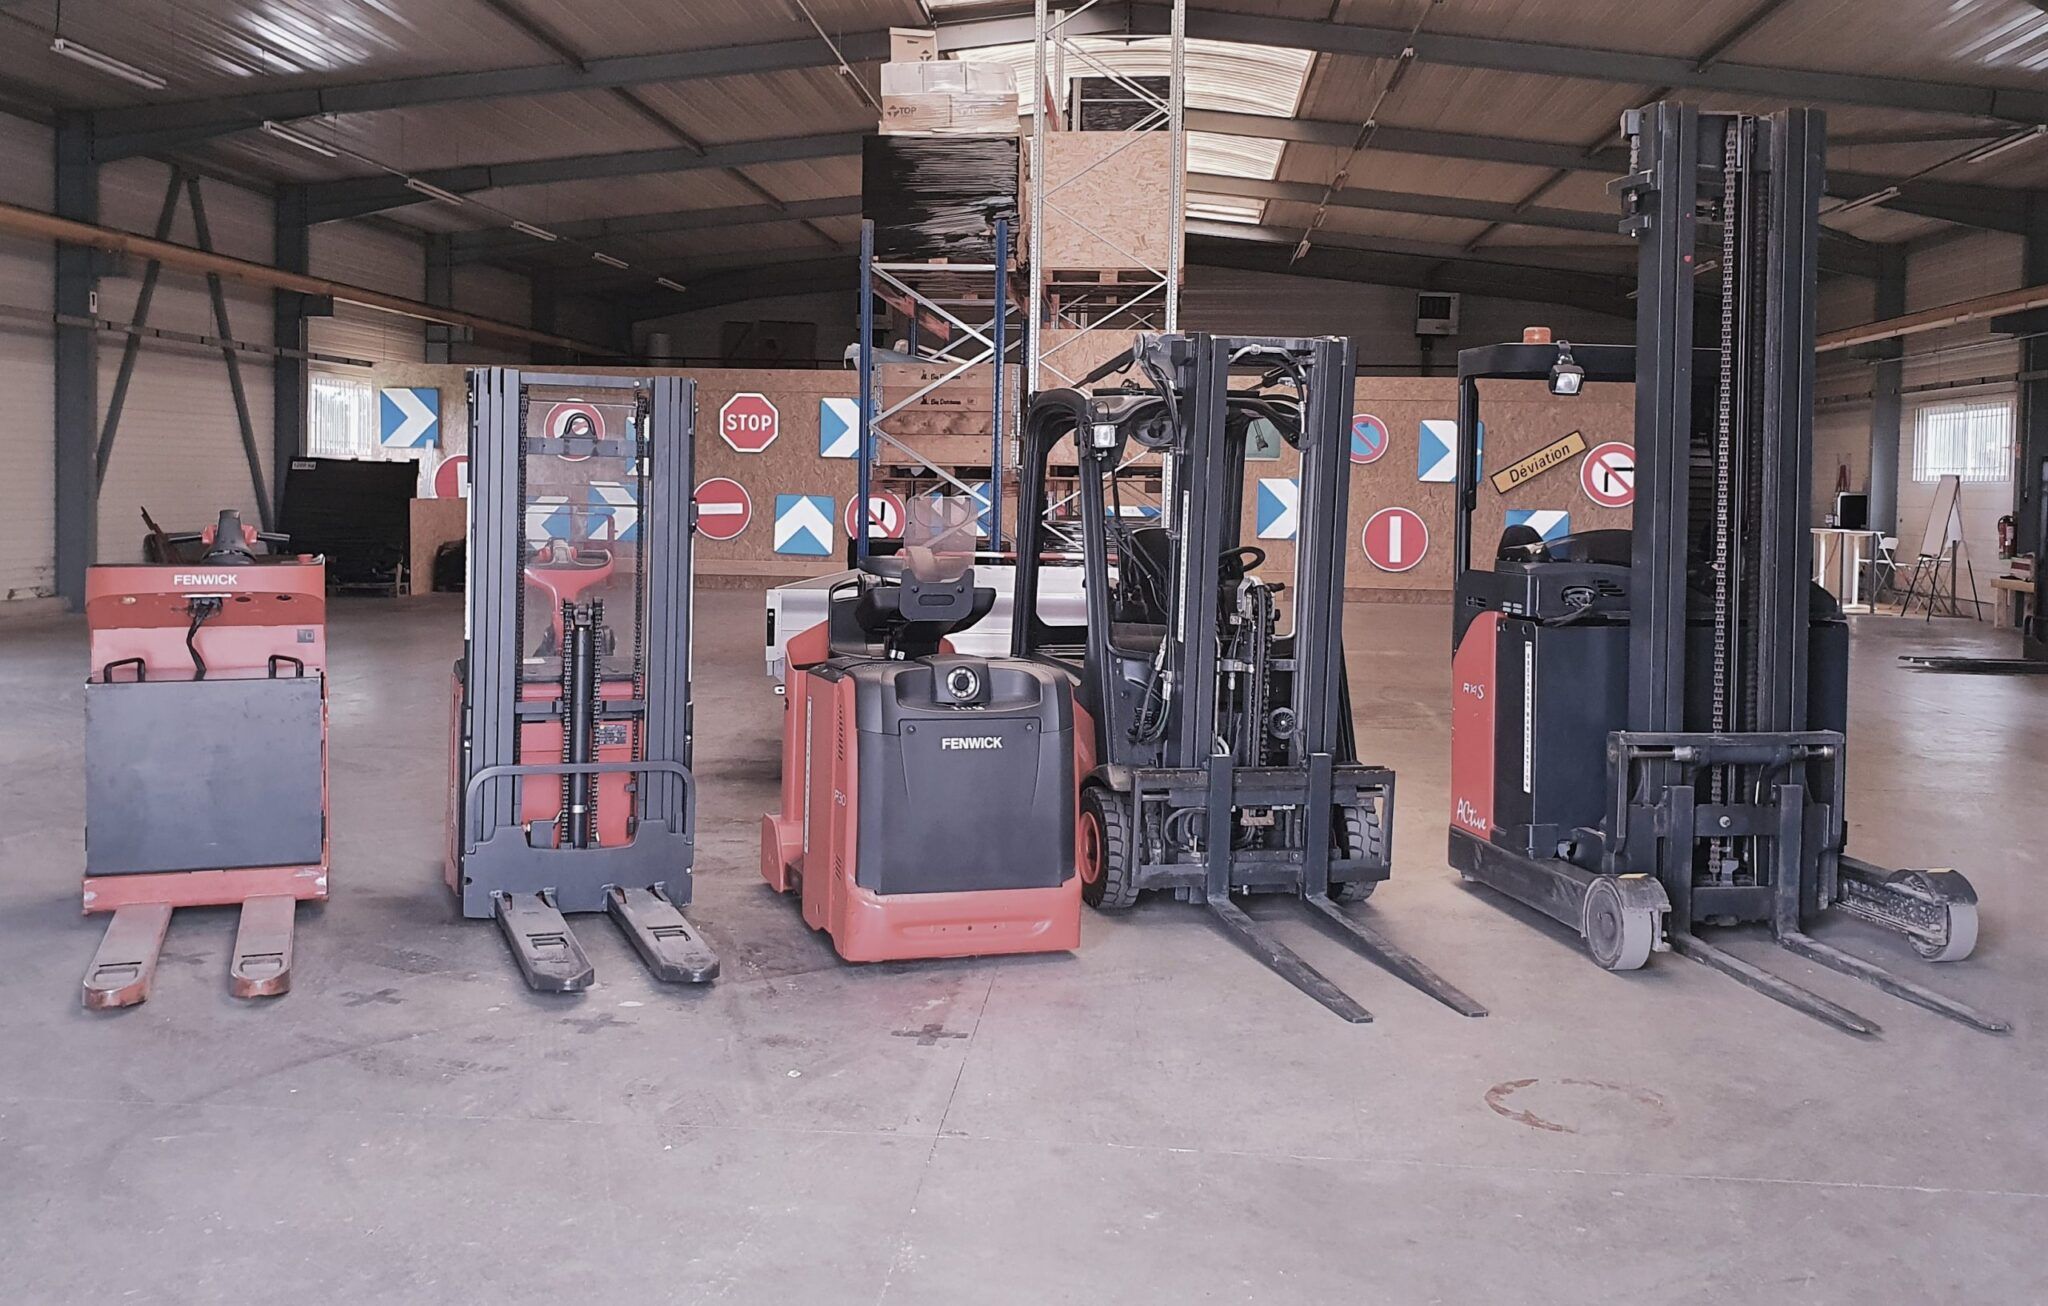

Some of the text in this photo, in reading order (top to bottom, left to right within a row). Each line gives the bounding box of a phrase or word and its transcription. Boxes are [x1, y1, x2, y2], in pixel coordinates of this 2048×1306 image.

[899, 106, 917, 115] TOP
[726, 413, 772, 432] STOP
[1509, 444, 1571, 483] Déviation
[173, 574, 238, 586] FENWICK
[942, 736, 1003, 750] FENWICK
